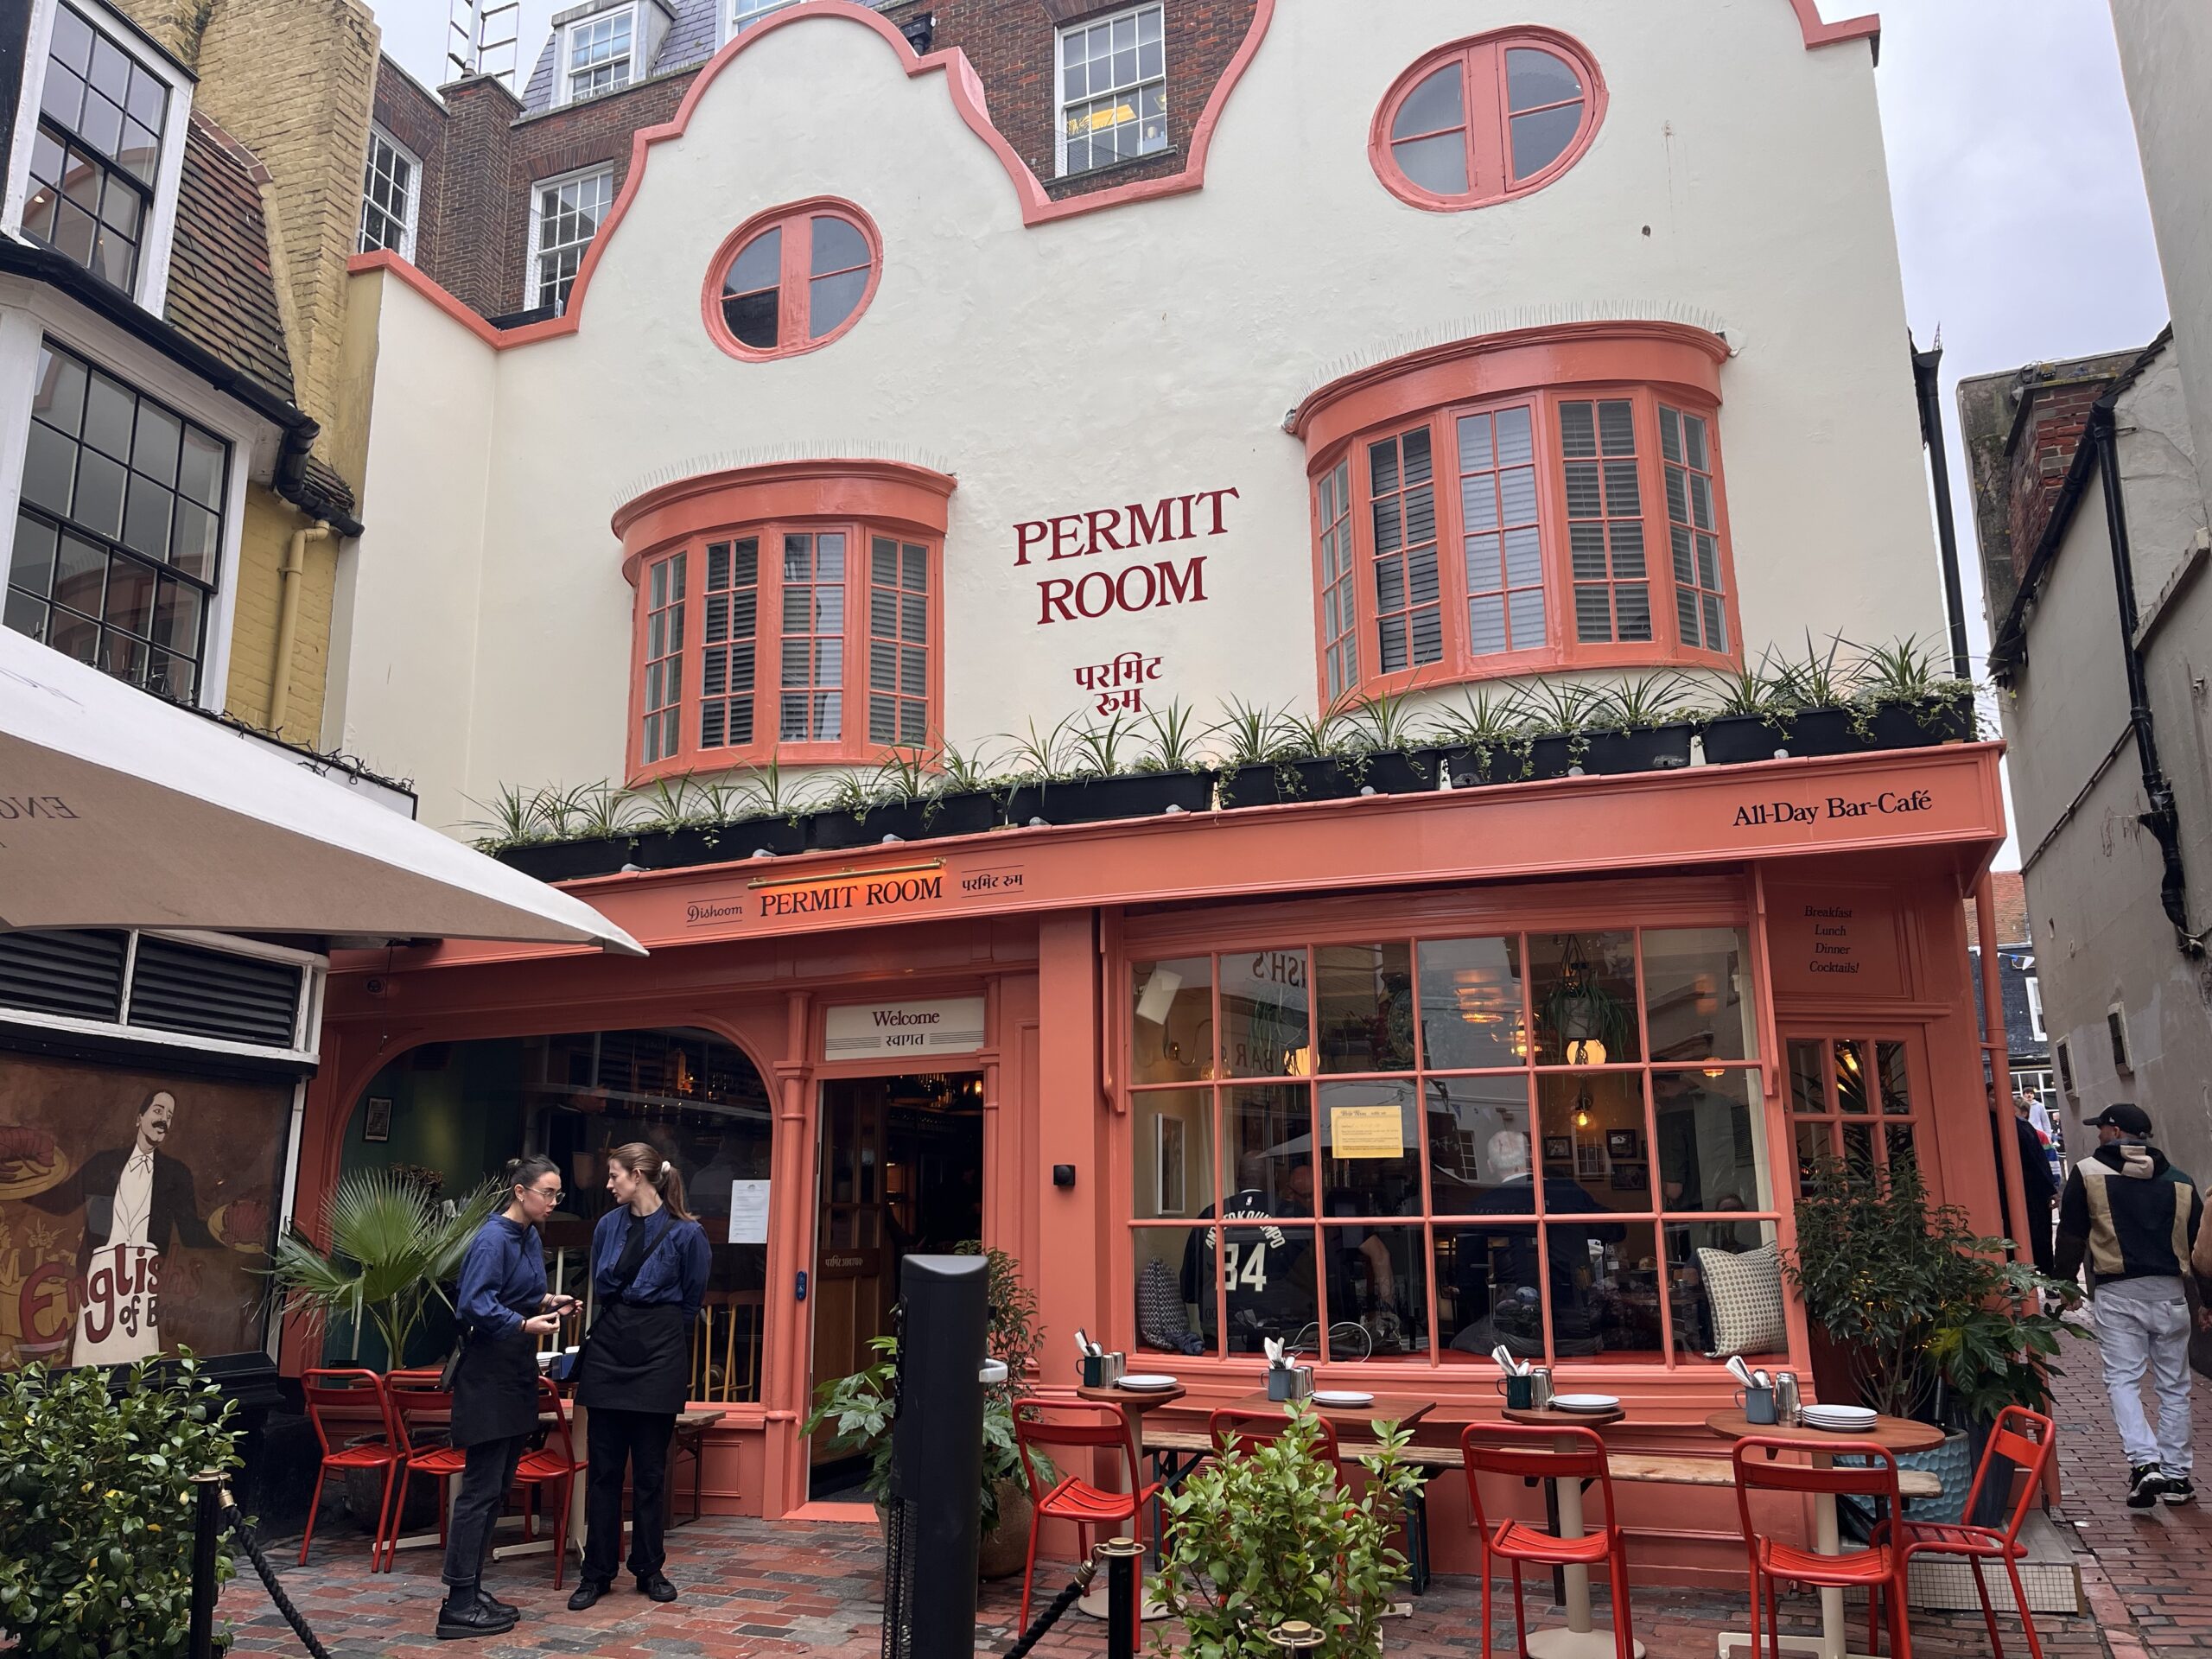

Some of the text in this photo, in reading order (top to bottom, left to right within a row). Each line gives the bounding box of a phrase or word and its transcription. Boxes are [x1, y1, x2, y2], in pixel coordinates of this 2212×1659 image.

[1013, 487, 1240, 566] PERMIT
[1037, 556, 1208, 625] ROOM
[1073, 652, 1164, 690] परमिट
[1732, 790, 1933, 827] All-Day Bar-Café
[962, 874, 999, 891] परमिट
[686, 876, 943, 923] Dishoom PERMIT ROOM
[1804, 905, 1853, 918] Breakfast
[1815, 924, 1847, 936] Lunch
[1815, 942, 1851, 954] Dinner
[1809, 960, 1859, 974] Cocktails!
[872, 1010, 940, 1027] Welcome
[886, 1033, 925, 1046] स्वागत
[1216, 1243, 1267, 1292] 34
[119, 1295, 140, 1338] of
